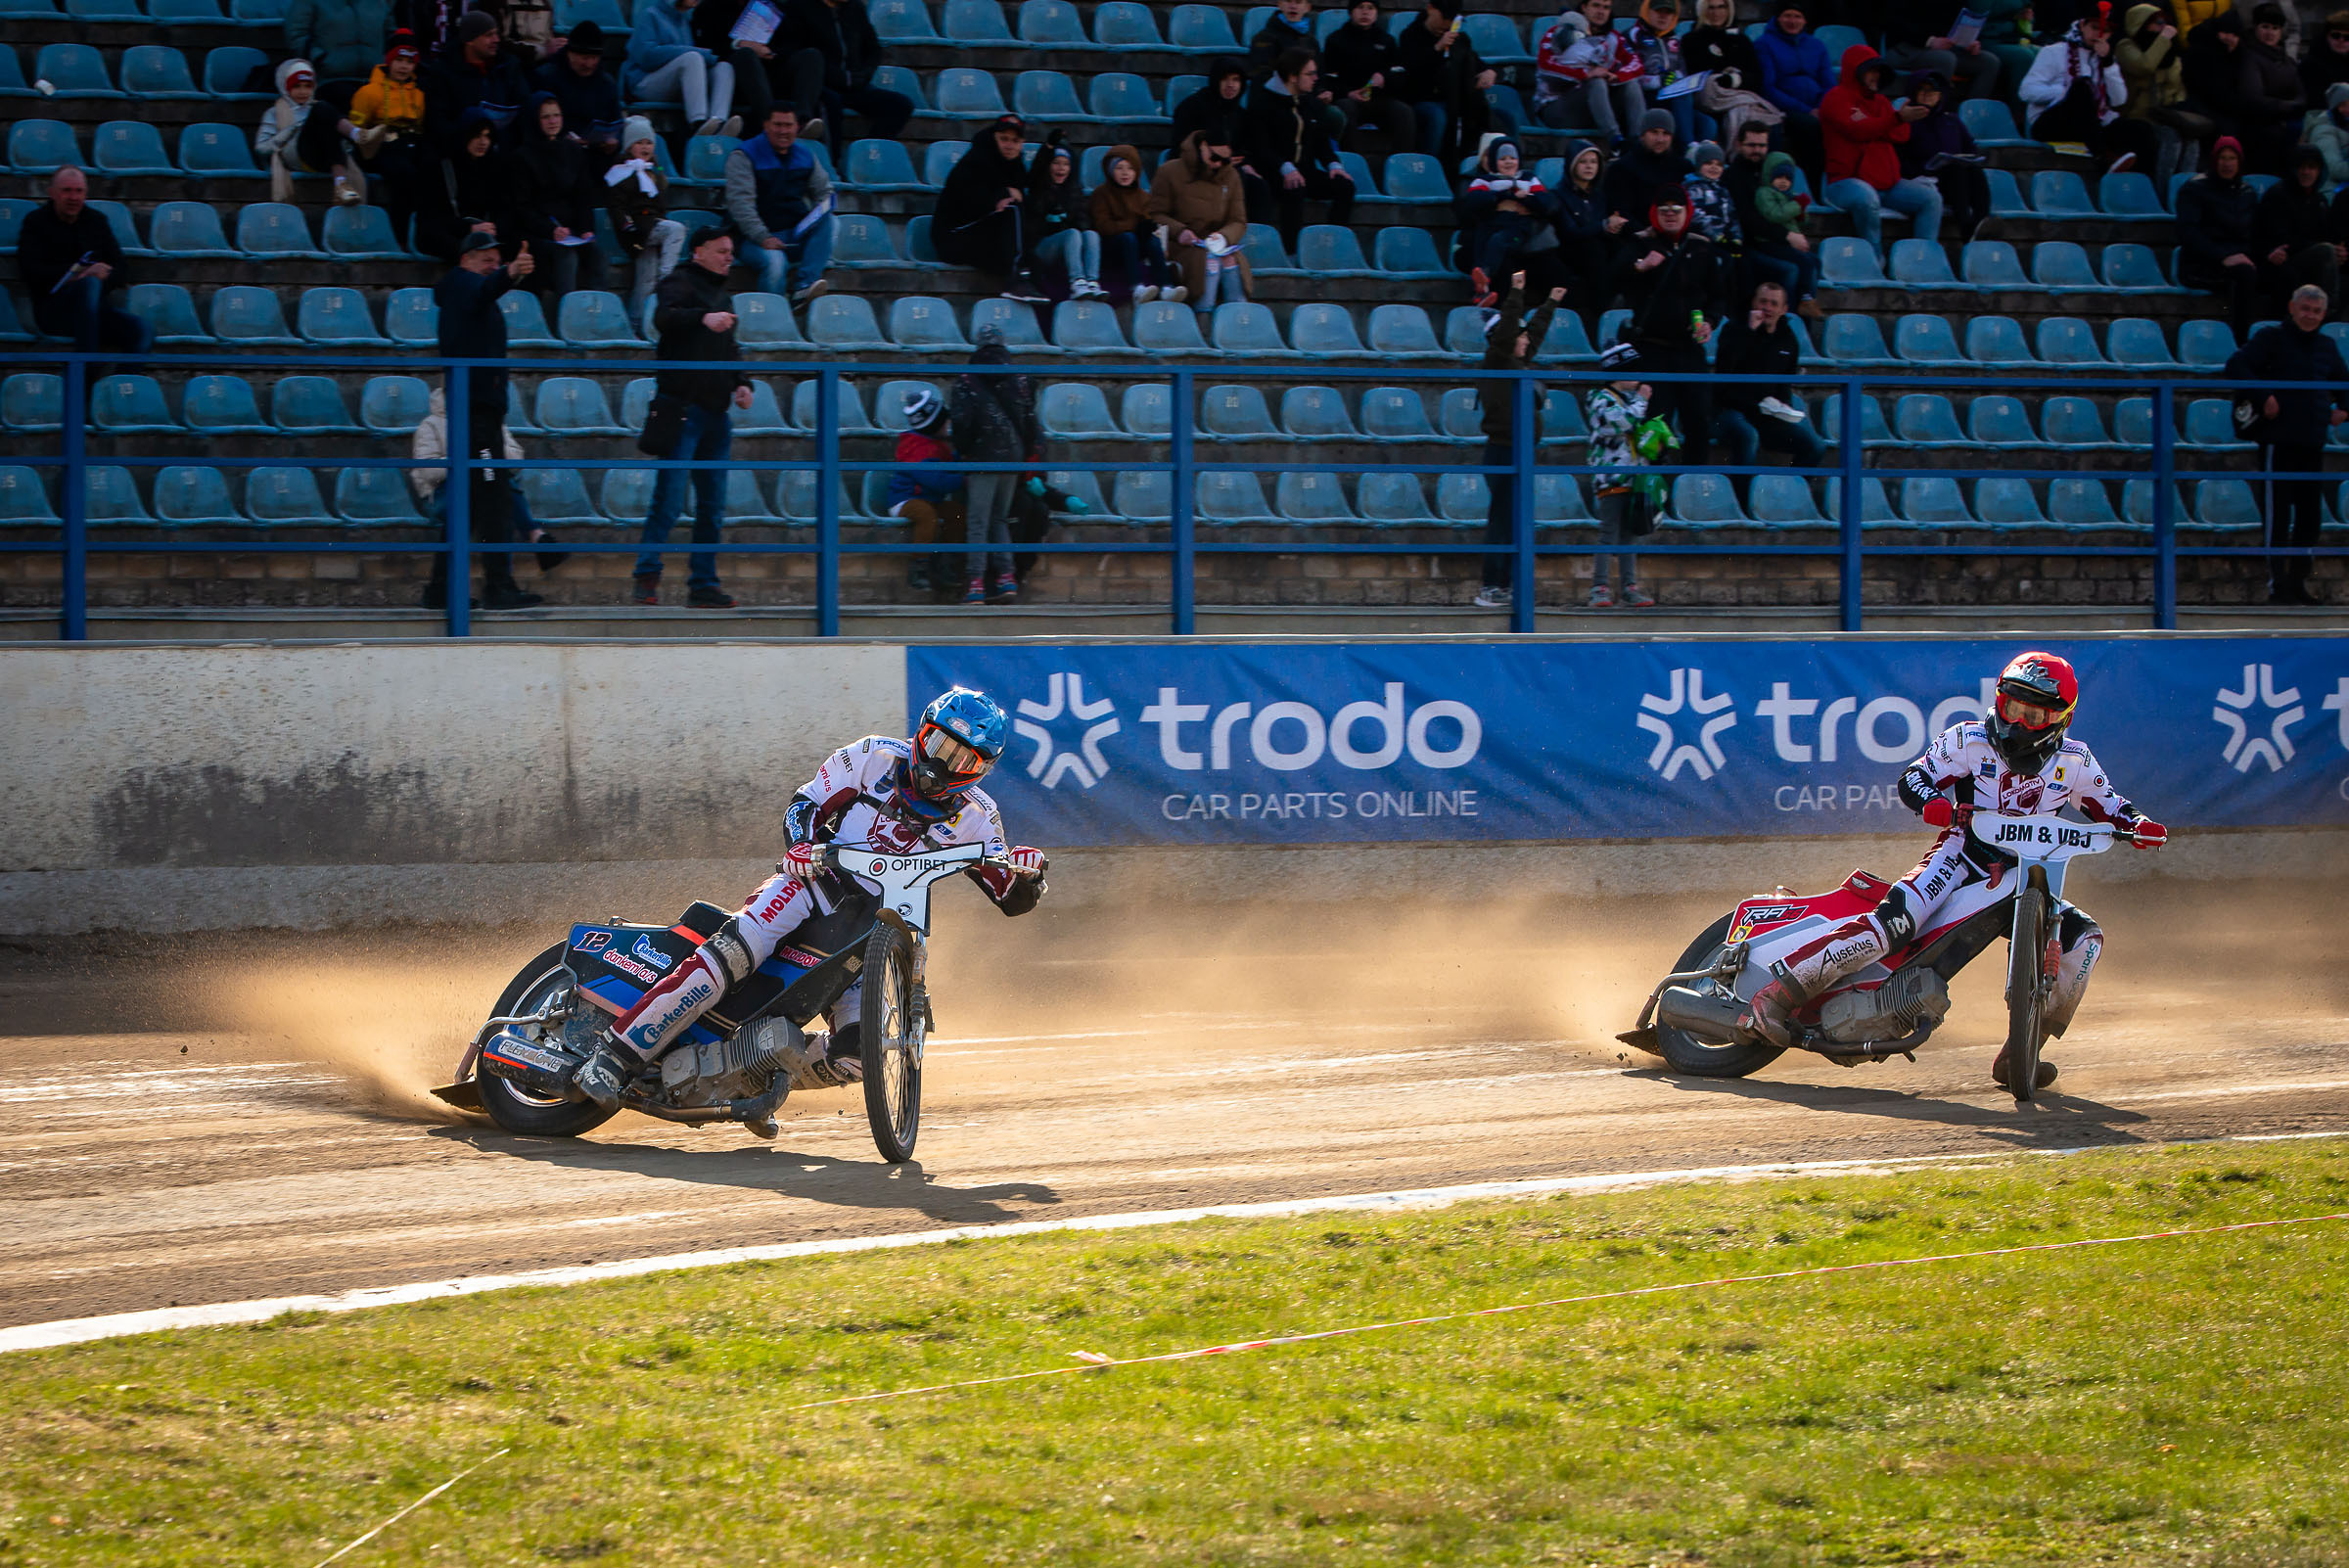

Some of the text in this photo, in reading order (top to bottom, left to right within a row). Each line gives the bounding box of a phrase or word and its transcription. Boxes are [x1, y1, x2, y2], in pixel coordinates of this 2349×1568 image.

[1139, 682, 1482, 770] trodo
[1755, 677, 1998, 762] trod
[1162, 790, 1479, 820] CAR PARTS ONLINE
[1773, 783, 1902, 811] CAR PAR
[1995, 824, 2092, 849] JBM & VBJ
[891, 858, 947, 871] OPTIBET
[1923, 874, 1947, 901] JBM
[1942, 868, 1954, 881] &
[574, 931, 613, 952] 12
[638, 944, 673, 966] BarkerBille
[647, 984, 713, 1040] BarkerBille
